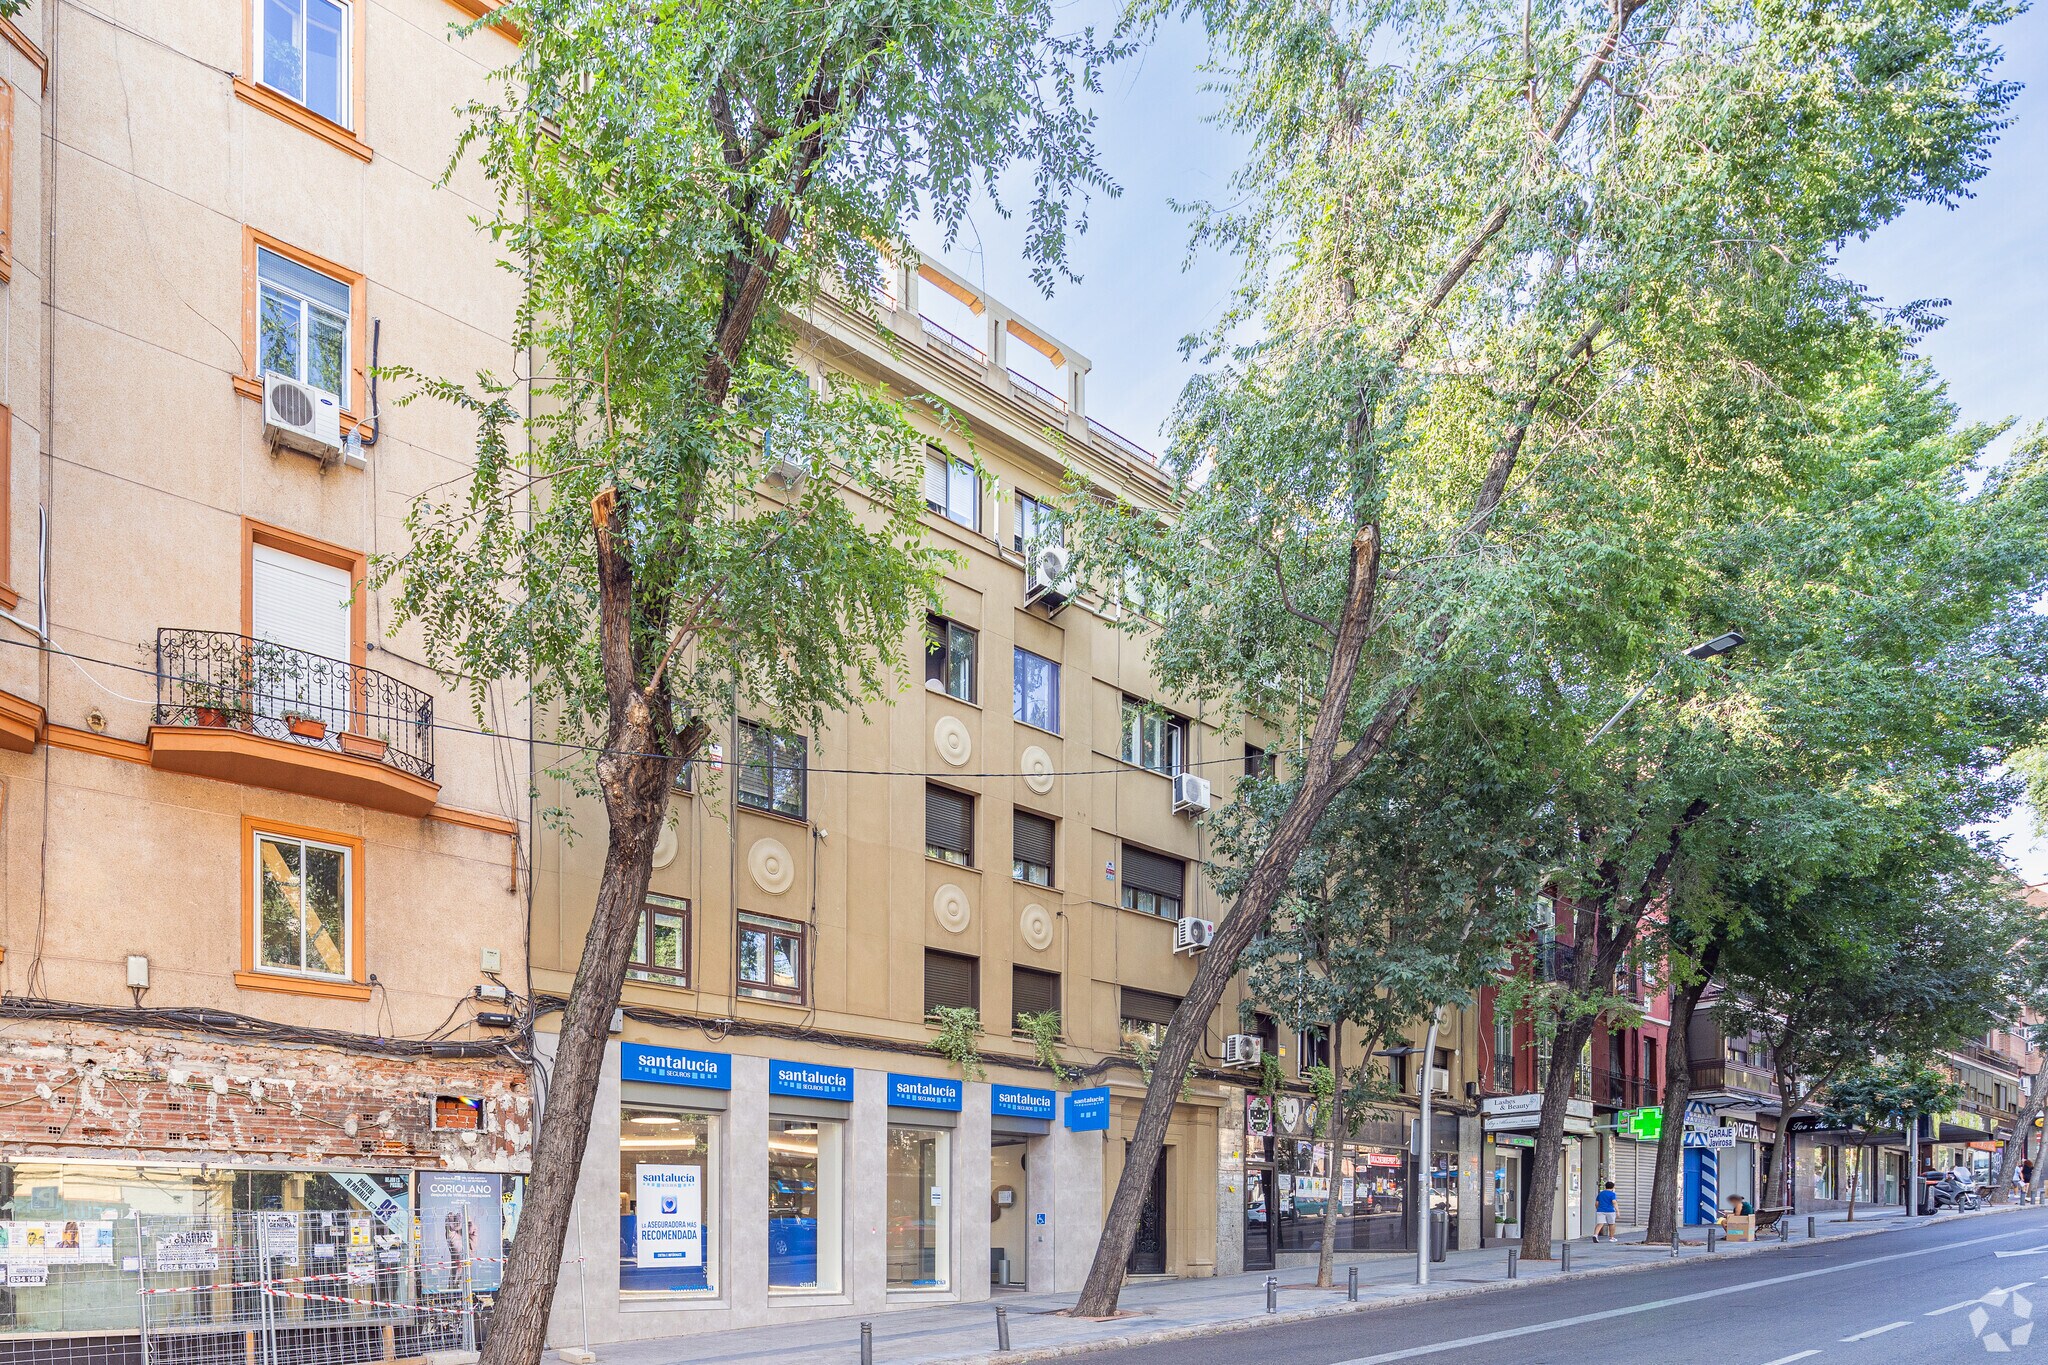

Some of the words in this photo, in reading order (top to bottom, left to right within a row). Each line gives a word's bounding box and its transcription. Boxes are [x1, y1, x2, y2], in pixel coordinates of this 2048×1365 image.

[638, 1054, 718, 1073] santalucía
[666, 1070, 691, 1079] SEGUROS
[778, 1069, 846, 1086] santalucía
[802, 1083, 824, 1092] SEGUROS
[896, 1082, 956, 1098] santalucía
[999, 1093, 1051, 1107] santalucía
[1507, 1102, 1530, 1110] Beauty
[1708, 1128, 1733, 1139] GARAJE
[1708, 1139, 1733, 1148] Javirosa
[344, 1177, 353, 1187] TU
[351, 1183, 371, 1202] PANTALLA
[357, 1177, 377, 1197] PROTEGE
[429, 1183, 492, 1194] CORIOLANO
[647, 1220, 687, 1229] ASEGURADORA
[641, 1229, 698, 1241] RECOMENDADA
[174, 1237, 214, 1245] GENERAL
